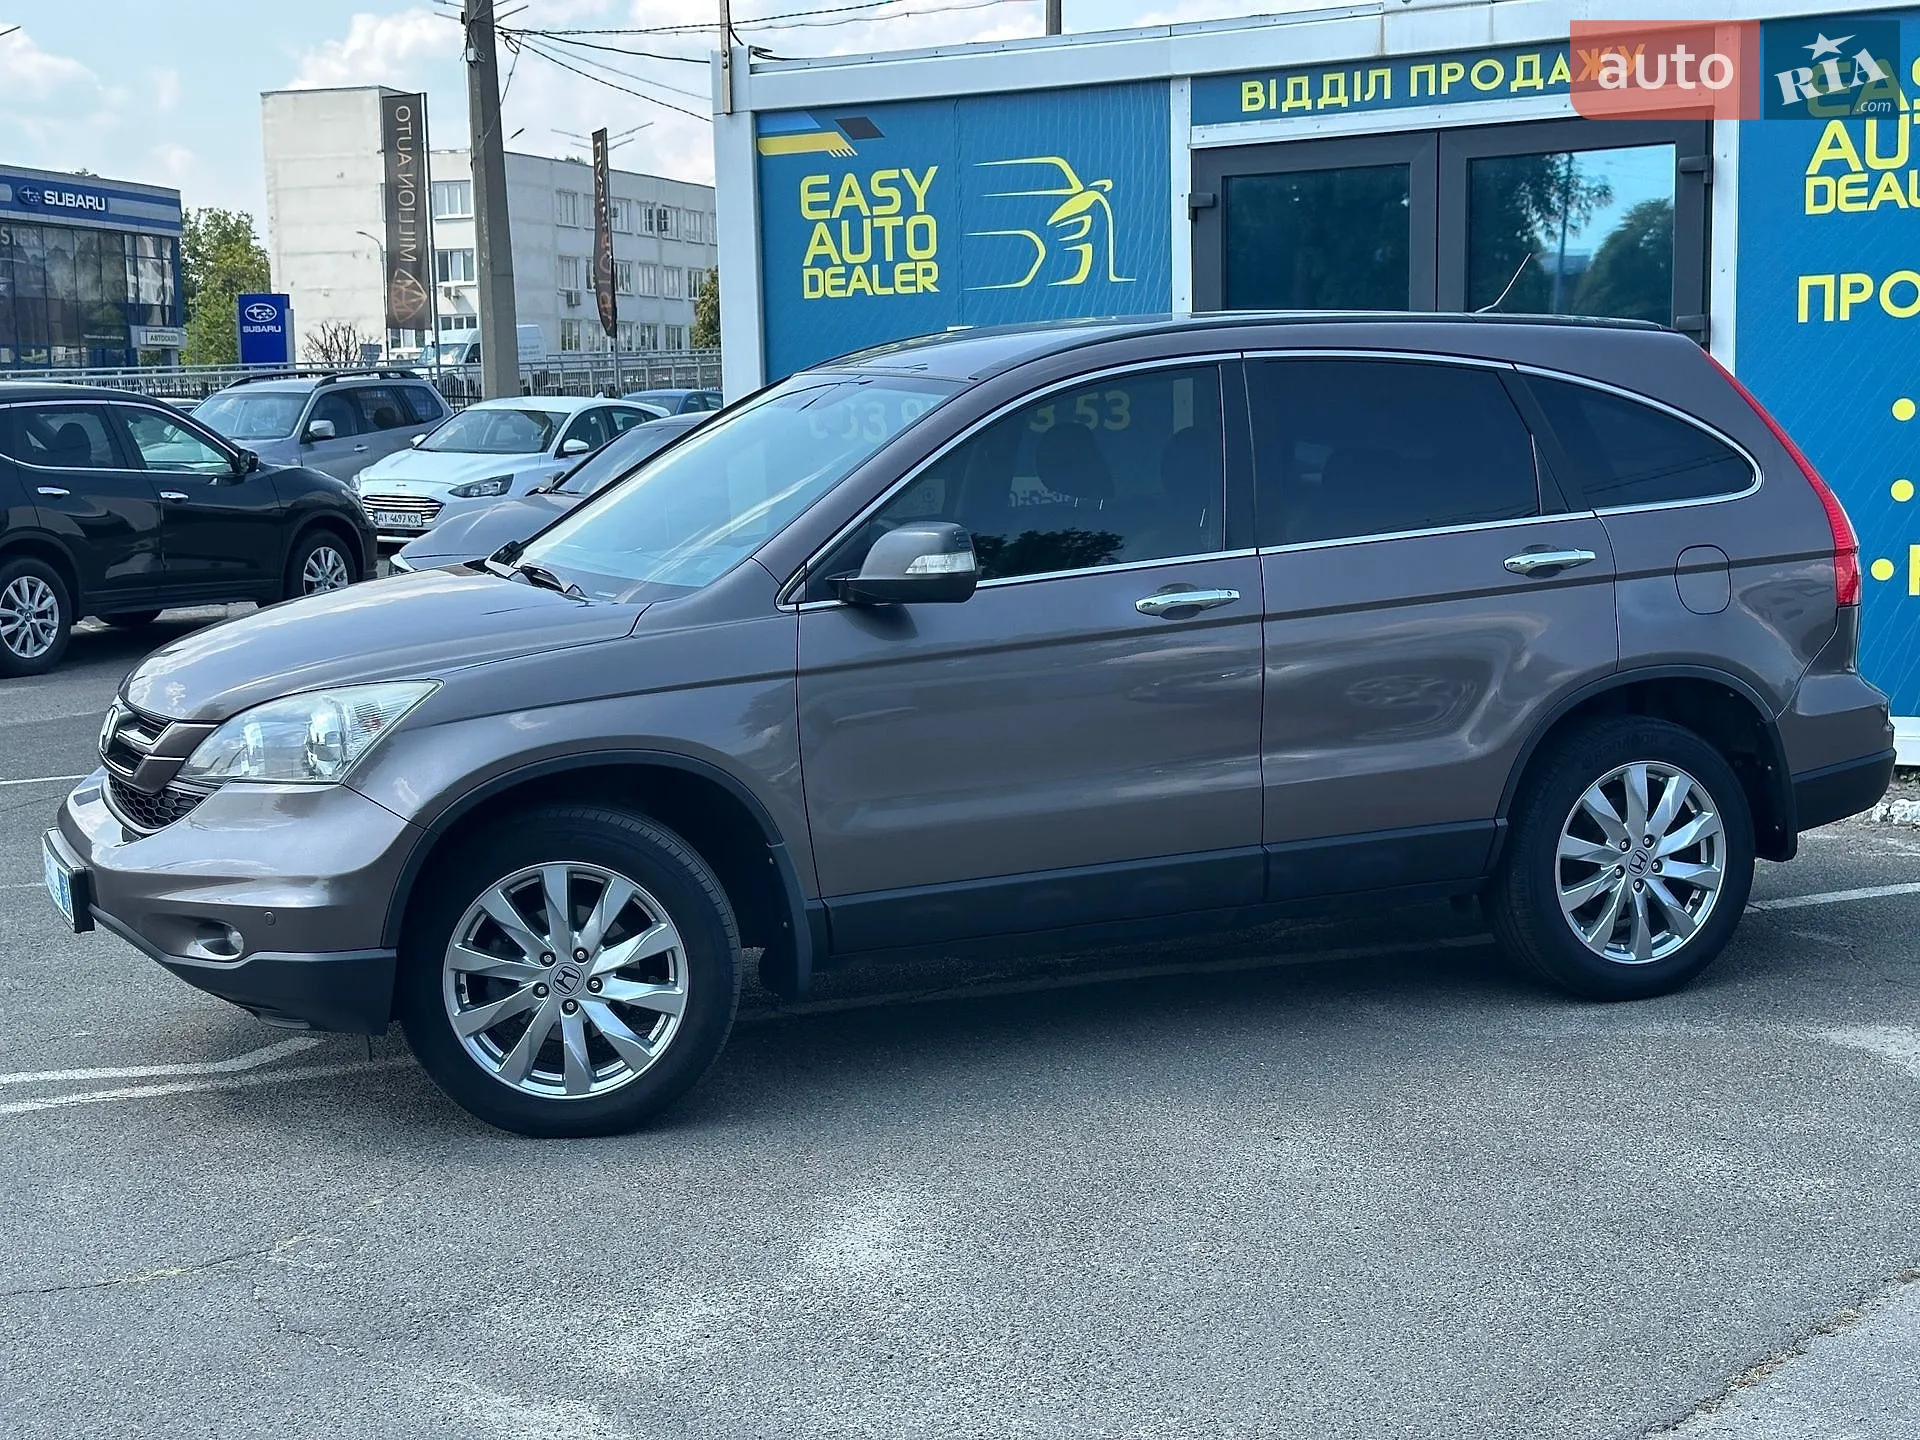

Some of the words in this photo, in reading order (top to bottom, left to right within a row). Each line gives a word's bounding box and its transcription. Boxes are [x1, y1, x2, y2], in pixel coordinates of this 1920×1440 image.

[1241, 67, 1392, 113] ВІДДІЛ
[1805, 112, 1920, 175] AU
[44, 190, 106, 211] SUBARU
[800, 165, 939, 220] EASY
[802, 214, 938, 267] AUTO
[803, 260, 940, 299] DEALER
[242, 325, 282, 333] SUBARU
